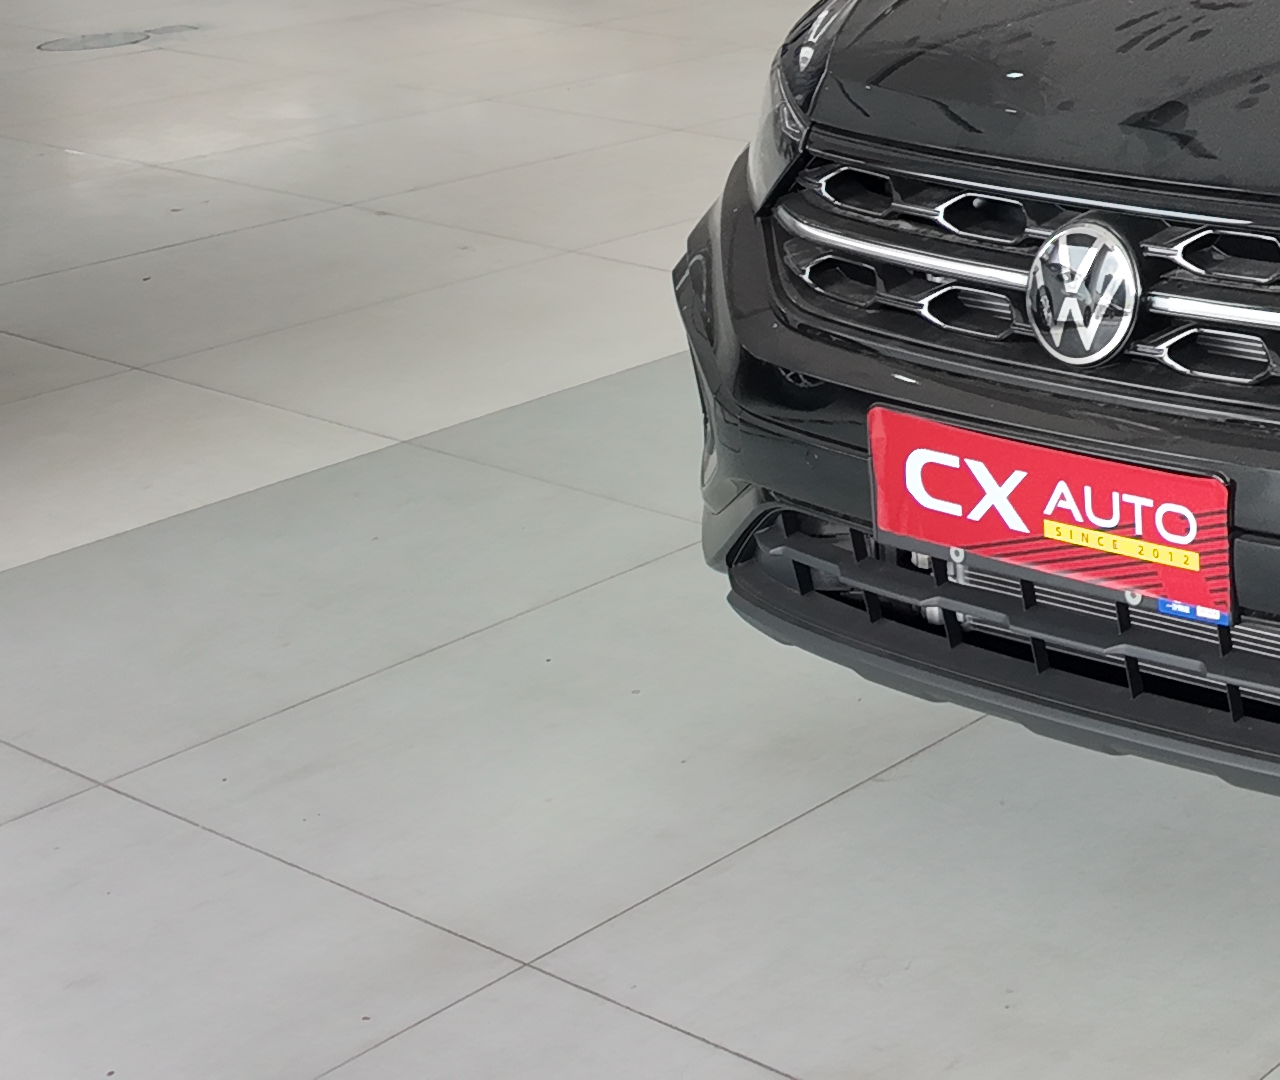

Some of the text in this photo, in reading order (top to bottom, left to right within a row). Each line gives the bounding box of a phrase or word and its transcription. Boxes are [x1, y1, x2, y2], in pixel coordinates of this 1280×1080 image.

[905, 448, 1198, 545] CX AUTO
[1055, 526, 1190, 566] SINCE 2012
